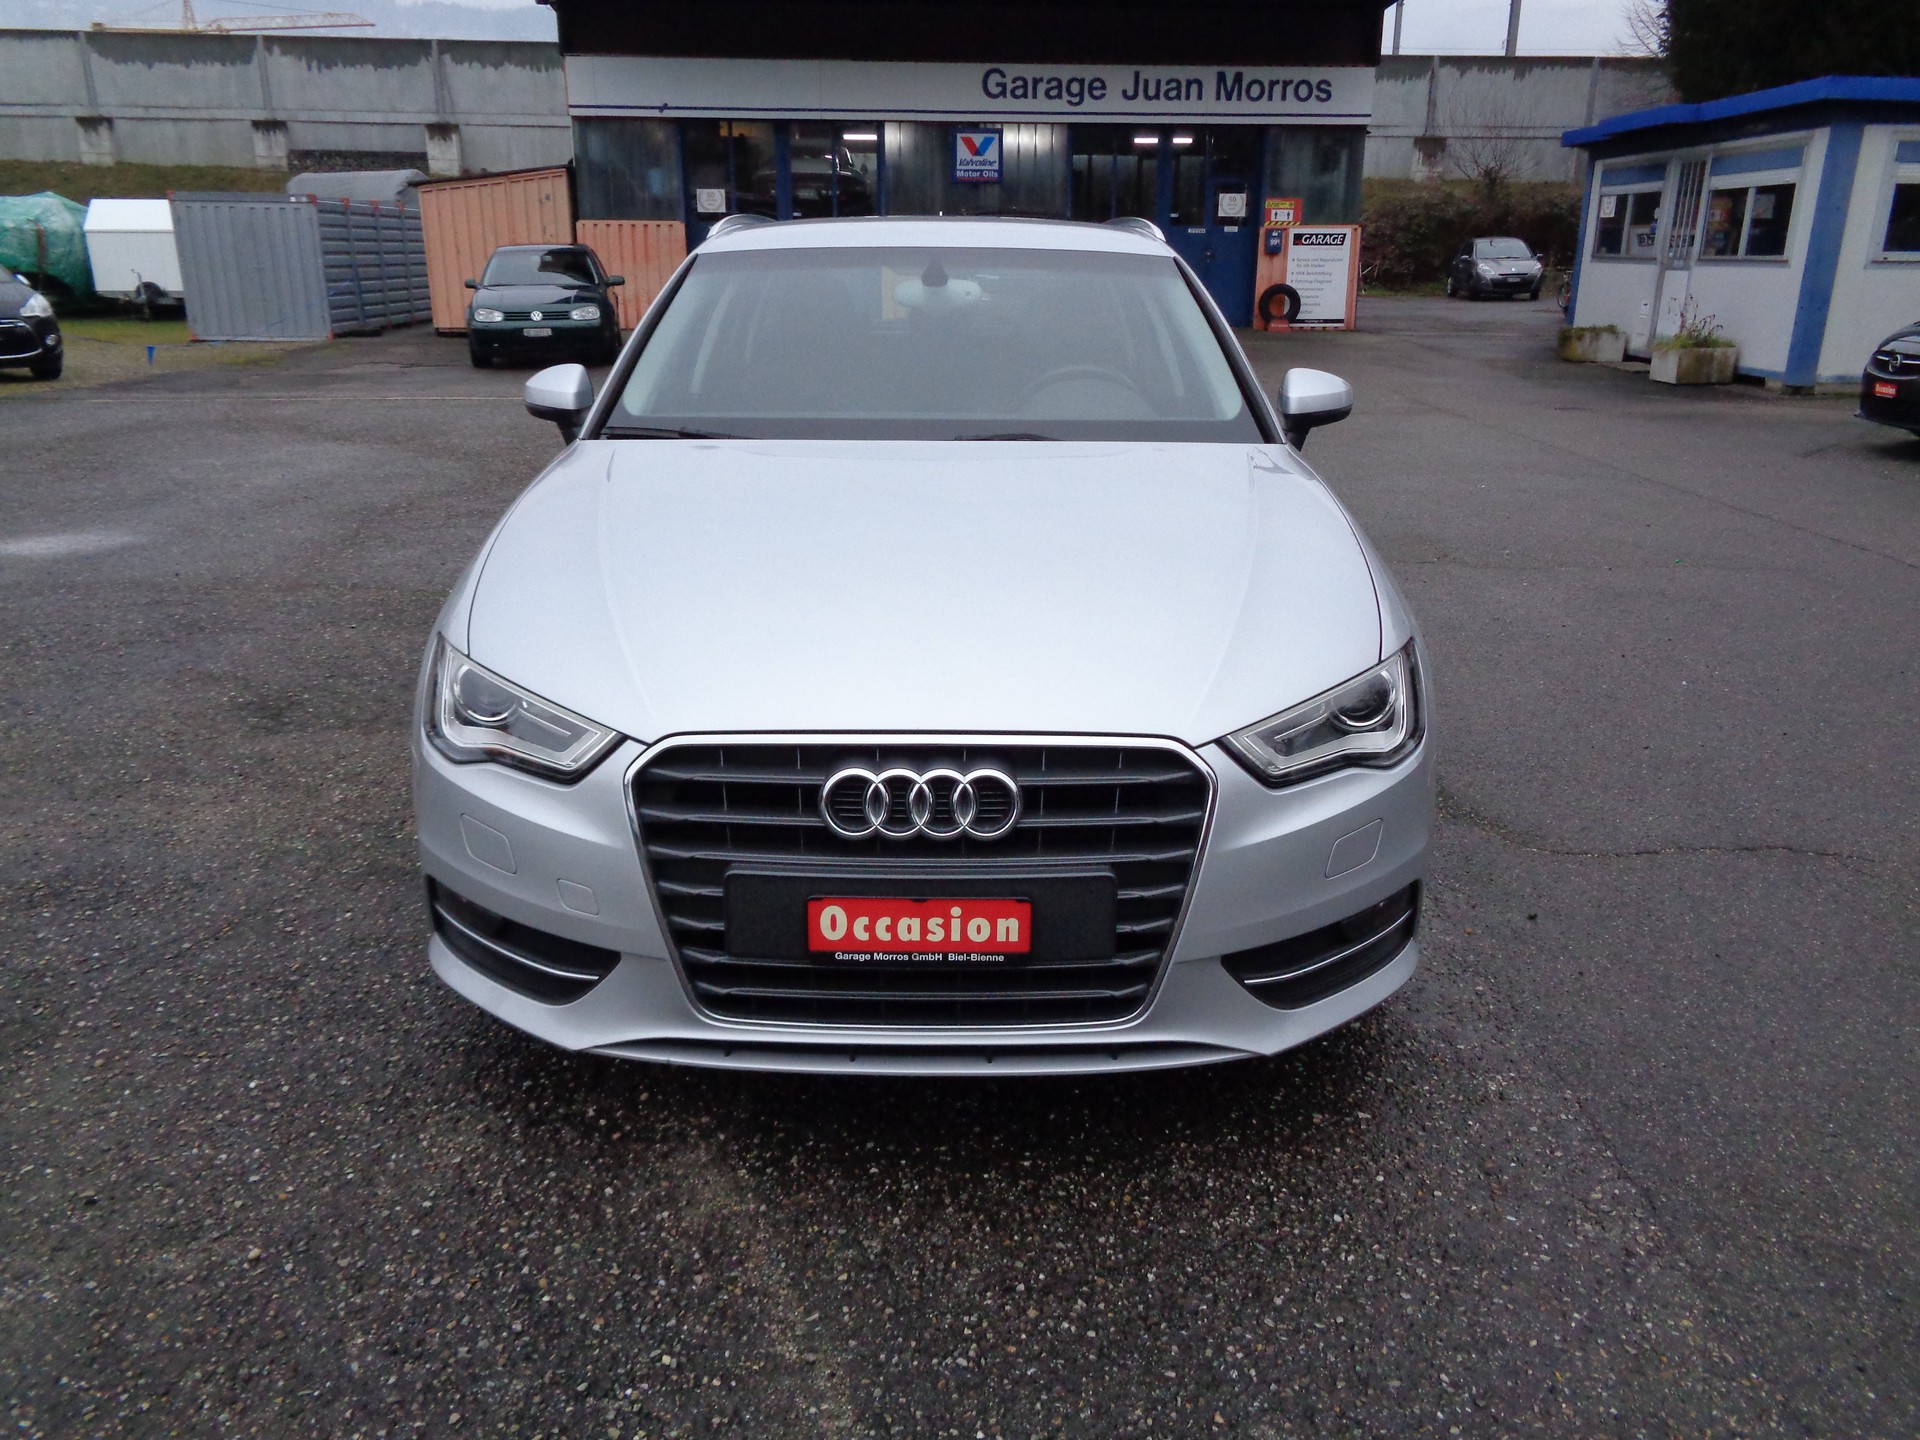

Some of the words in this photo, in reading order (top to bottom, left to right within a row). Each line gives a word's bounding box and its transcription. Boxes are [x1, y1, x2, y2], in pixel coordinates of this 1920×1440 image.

[981, 68, 1107, 107] Garage
[1121, 71, 1203, 101] Juan
[1215, 71, 1333, 102] Morros
[959, 159, 997, 167] Valvoline
[1302, 234, 1344, 245] GARAGE
[819, 905, 1019, 942] Occasion
[835, 952, 871, 961] Garage
[873, 952, 909, 961] Morros
[912, 953, 942, 961] GmbH
[948, 953, 1004, 961] Biel-Bienne
